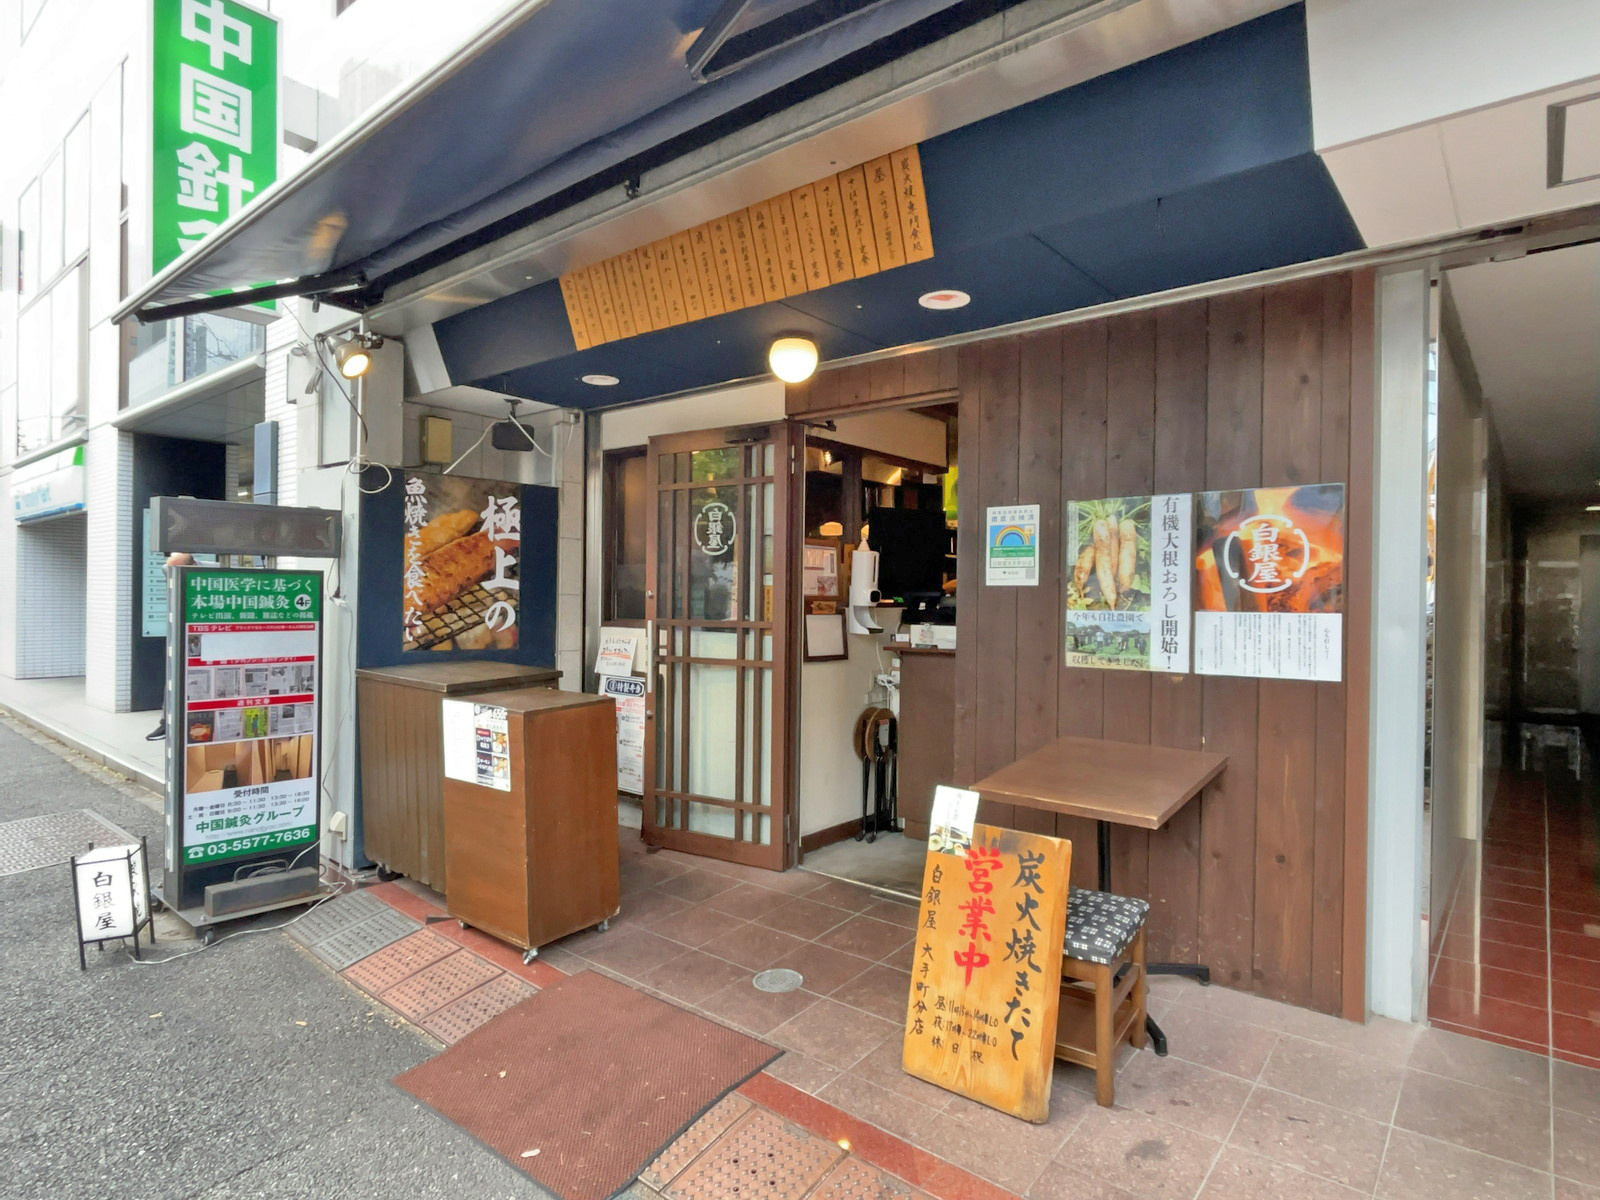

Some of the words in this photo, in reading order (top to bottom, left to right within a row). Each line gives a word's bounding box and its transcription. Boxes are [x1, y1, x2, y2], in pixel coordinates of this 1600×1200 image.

[176, 0, 254, 251] 中国針
[191, 577, 312, 592] 中国医学に基づく
[480, 496, 520, 632] 極上の
[1160, 497, 1179, 669] 有機大根おろし開始！
[1248, 523, 1283, 583] 白銀屋
[191, 594, 290, 610] 本場中国鍼灸
[196, 805, 304, 833] 中国鍼灸グループ
[233, 786, 269, 798] 受付時間
[207, 828, 310, 855] 03-5577-7636
[93, 871, 117, 930] 白銀屋
[923, 864, 943, 930] 白銀屋
[954, 846, 1003, 987] 営業中
[1002, 849, 1046, 1061] 炭火焼きたて
[909, 942, 934, 1035] 大手町分店
